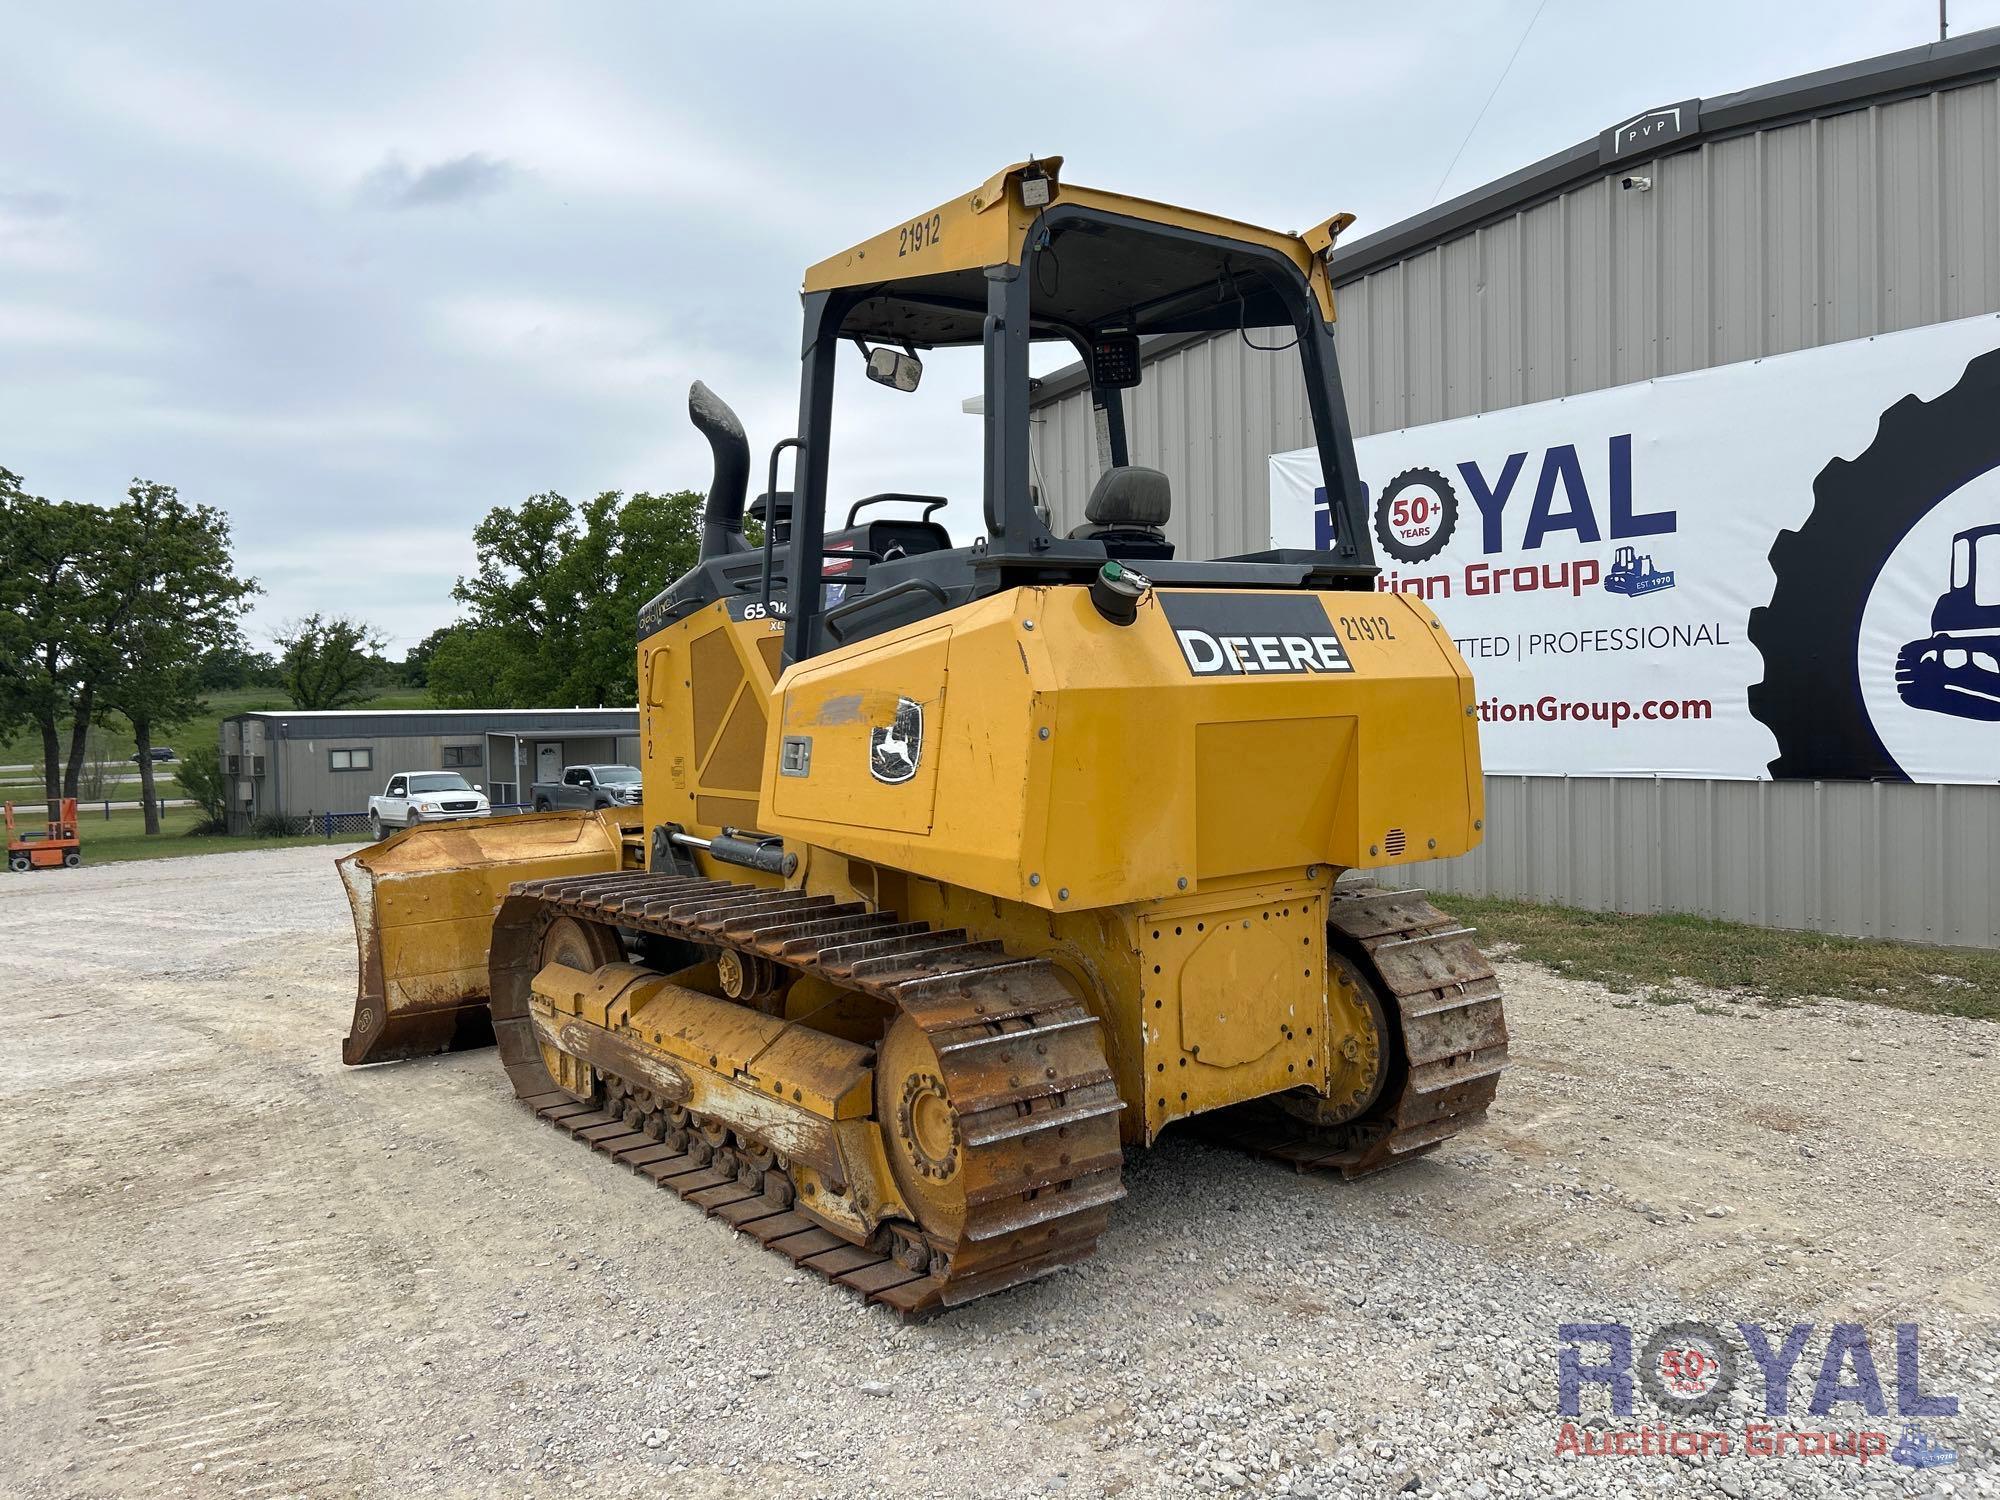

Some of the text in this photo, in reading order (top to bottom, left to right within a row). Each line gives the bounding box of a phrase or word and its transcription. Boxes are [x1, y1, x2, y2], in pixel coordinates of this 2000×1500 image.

[1629, 121, 1665, 142] PVP
[899, 213, 941, 257] 21912
[1392, 497, 1441, 526] 50+
[1400, 527, 1430, 538] YEARS
[1464, 559, 1599, 596] Group
[1652, 575, 1671, 585] 1970
[1340, 616, 1395, 641] 21912
[1529, 623, 1730, 655] PROFESSIONAL
[1176, 629, 1350, 673] DEERE
